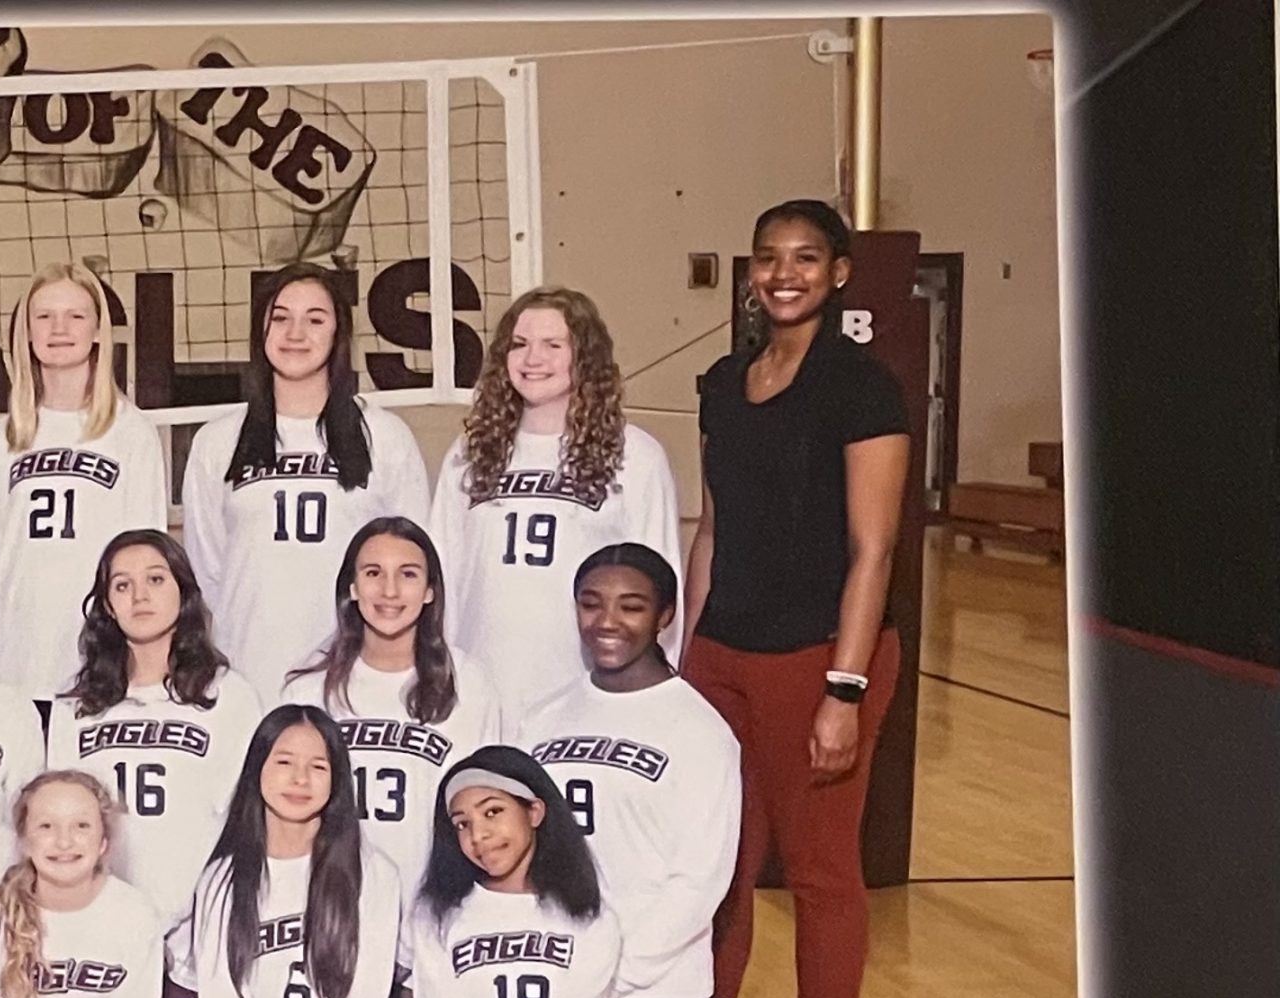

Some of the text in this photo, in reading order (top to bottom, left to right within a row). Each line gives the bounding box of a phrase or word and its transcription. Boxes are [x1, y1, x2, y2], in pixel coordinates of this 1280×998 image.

[23, 92, 131, 144] OF
[841, 309, 874, 344] B
[29, 489, 75, 539] 21
[274, 490, 327, 543] 10
[502, 512, 557, 567] 19
[79, 719, 210, 759] EAGLES
[339, 719, 453, 767] AGLES
[113, 761, 166, 817] 16
[353, 766, 406, 822] 13
